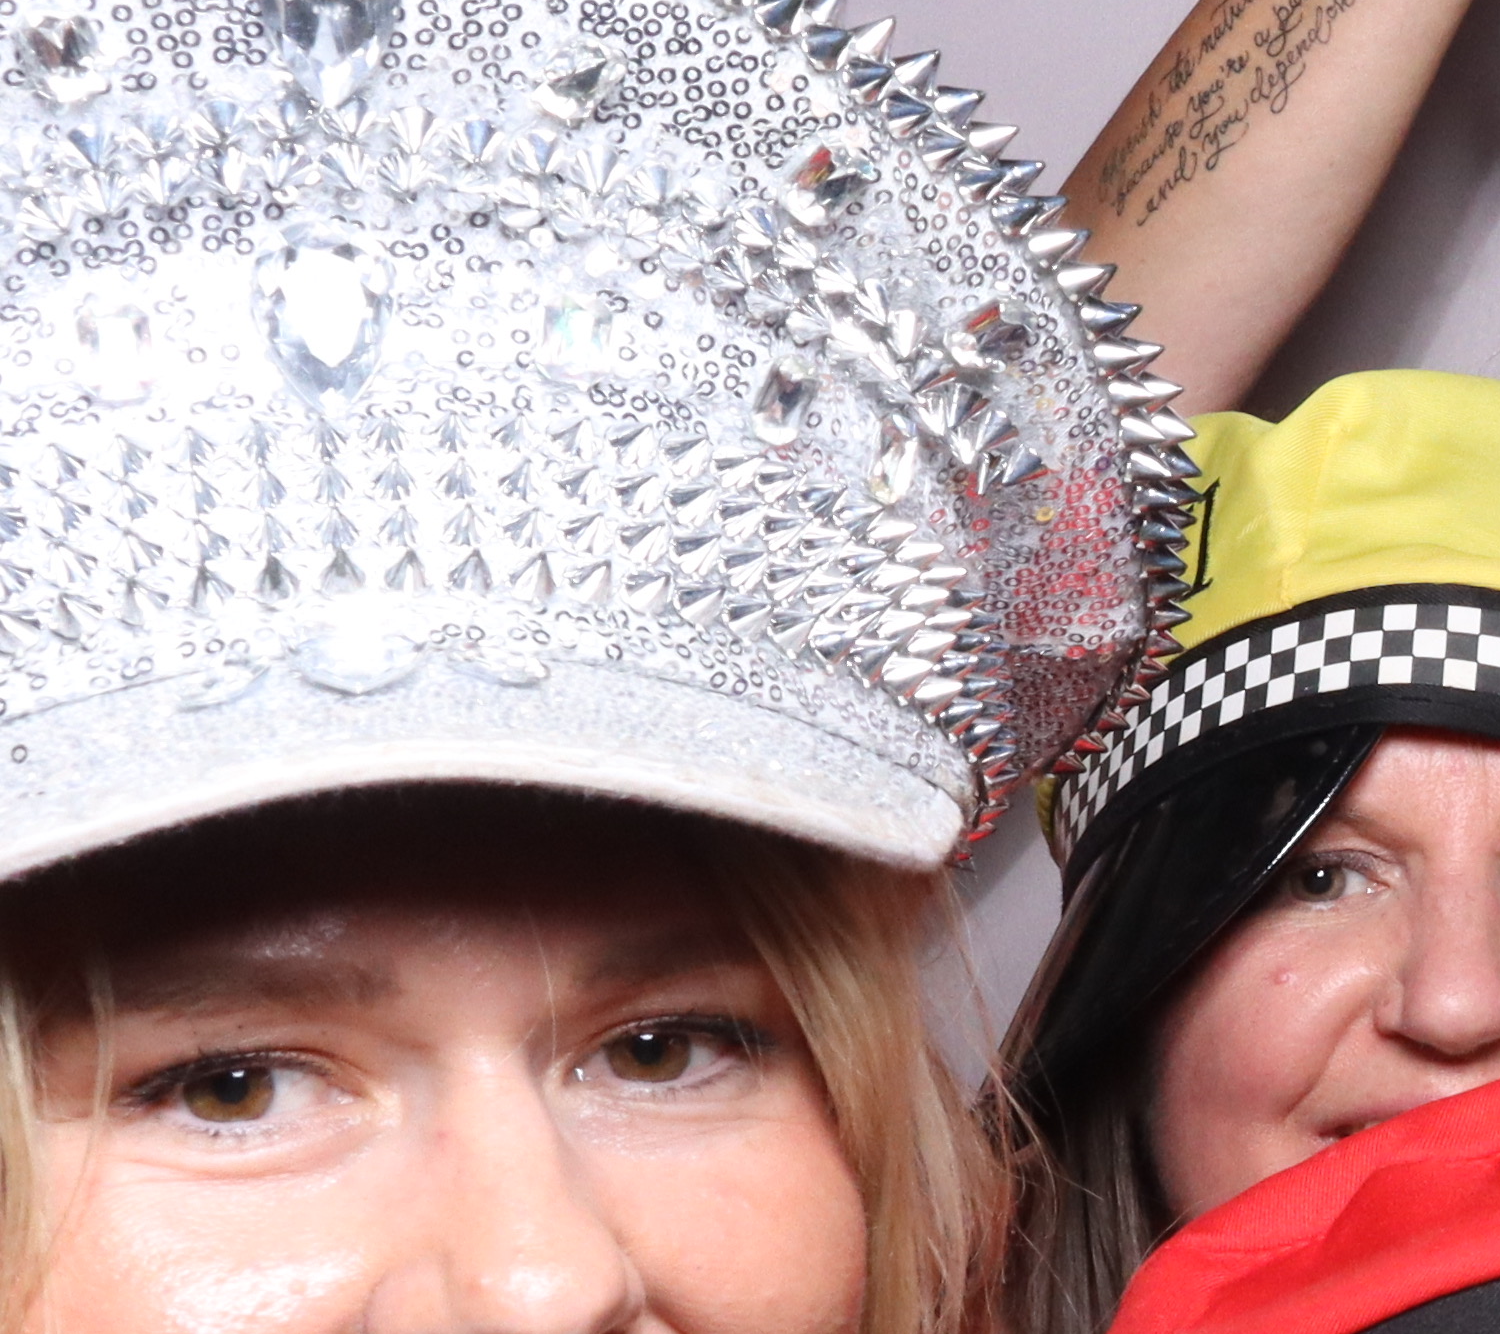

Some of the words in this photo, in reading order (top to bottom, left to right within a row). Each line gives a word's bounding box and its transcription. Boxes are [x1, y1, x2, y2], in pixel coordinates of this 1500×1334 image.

[1136, 145, 1197, 227] and
[1201, 98, 1249, 171] you
[1250, 5, 1331, 114] depend
[1186, 51, 1250, 139] you're
[1254, 28, 1271, 48] a
